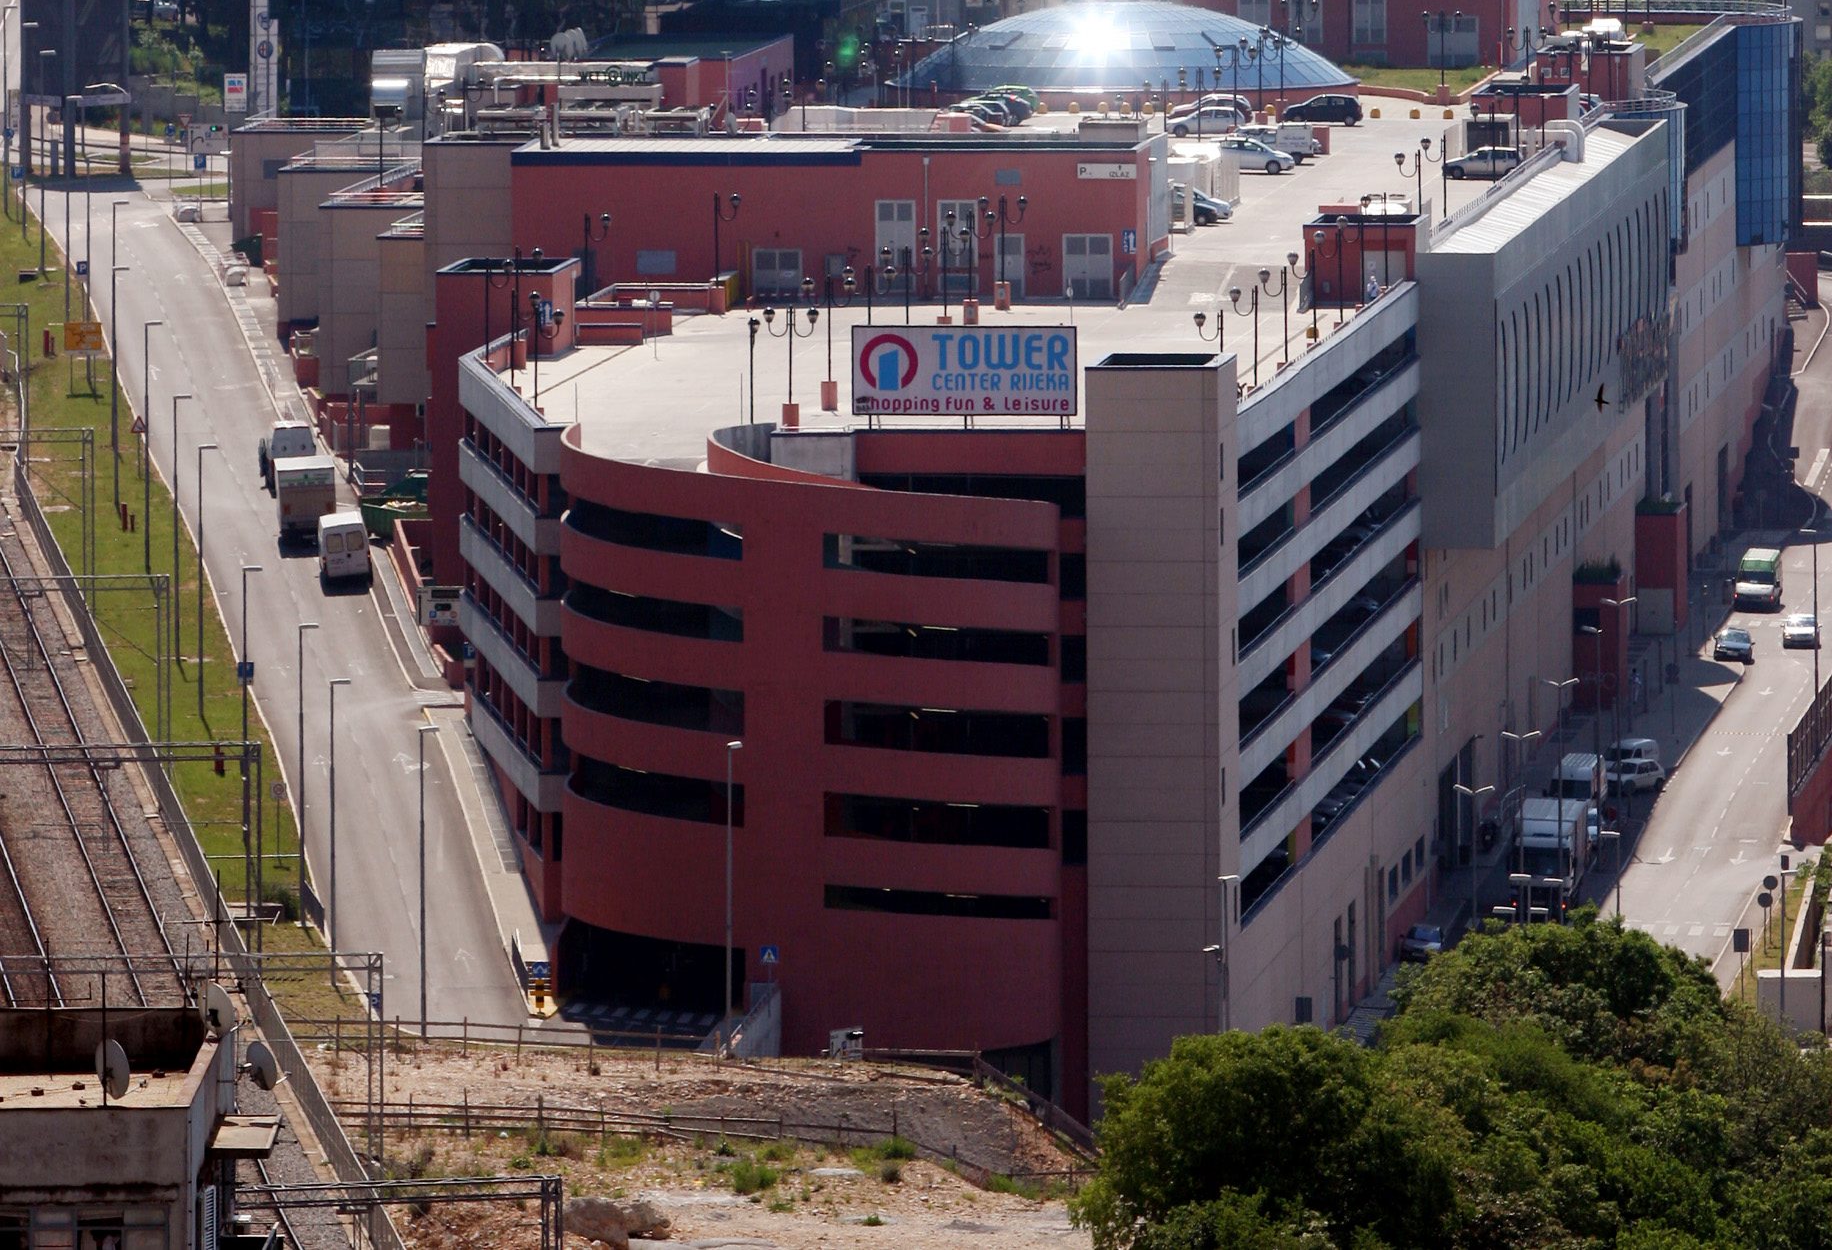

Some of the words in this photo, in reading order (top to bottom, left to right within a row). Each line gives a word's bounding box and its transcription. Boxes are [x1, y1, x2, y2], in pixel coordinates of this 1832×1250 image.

[1109, 171, 1130, 179] IZLAZ
[79, 263, 87, 273] P
[931, 333, 1070, 371] TOWER
[931, 373, 1002, 391] CENTER
[1010, 373, 1070, 391] RIJEKA
[945, 396, 974, 411] fun
[983, 396, 996, 411] &
[467, 644, 475, 657] P
